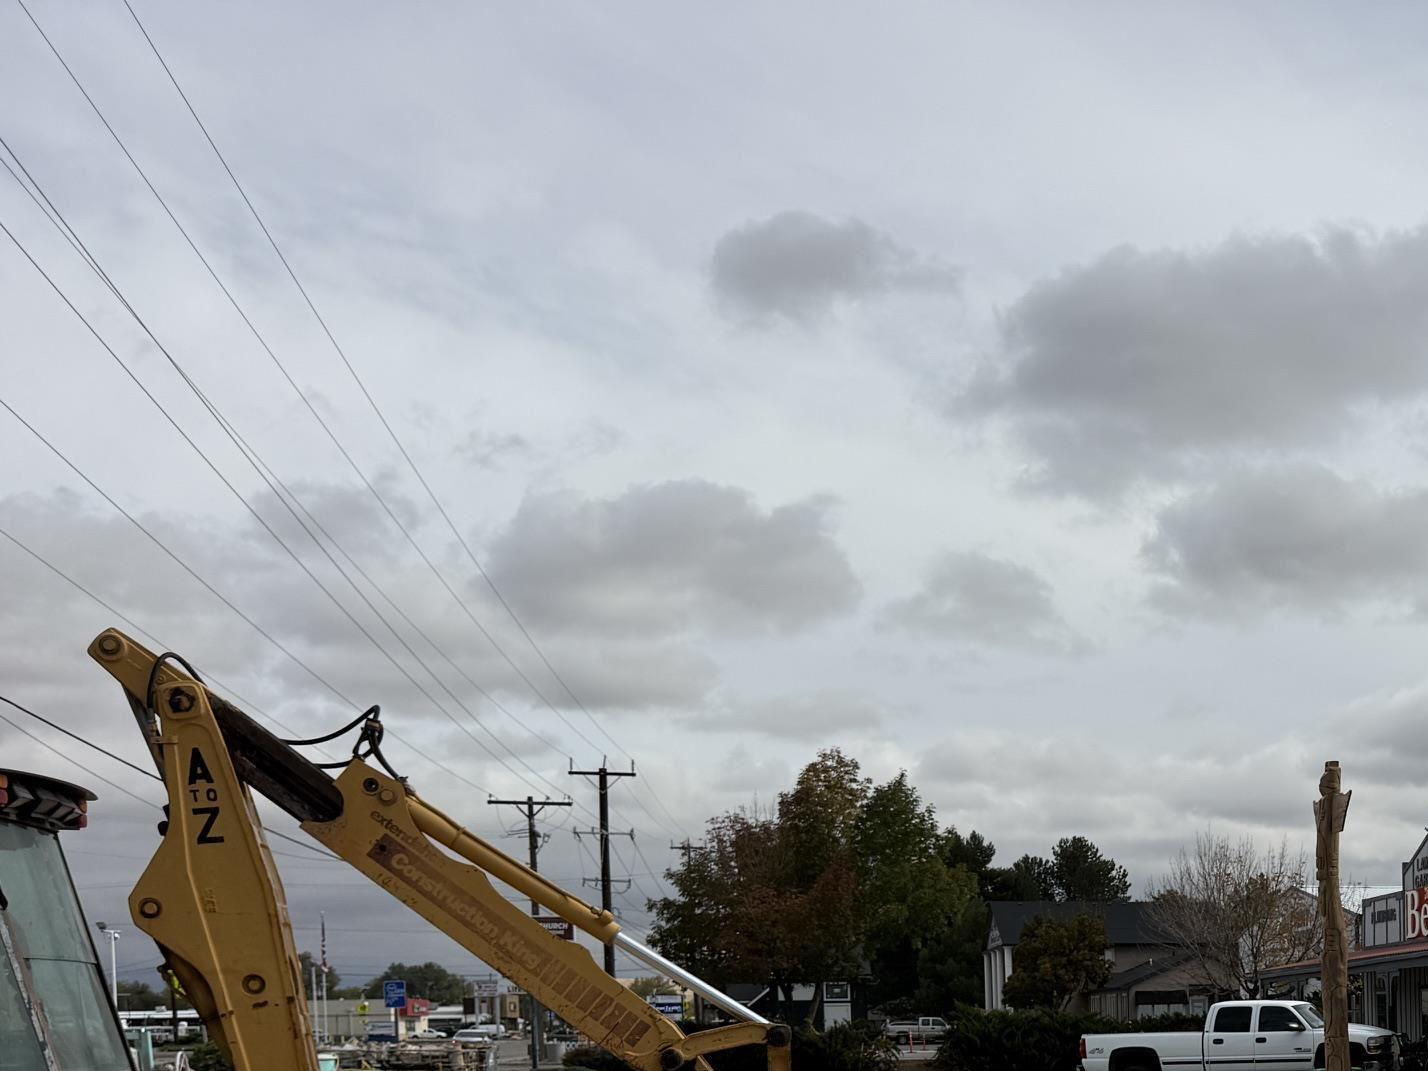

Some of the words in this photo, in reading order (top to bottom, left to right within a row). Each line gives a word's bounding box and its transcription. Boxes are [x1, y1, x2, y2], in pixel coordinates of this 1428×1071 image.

[188, 747, 214, 785] A
[189, 787, 218, 802] TO
[192, 806, 225, 844] Z
[541, 922, 568, 930] HURCH
